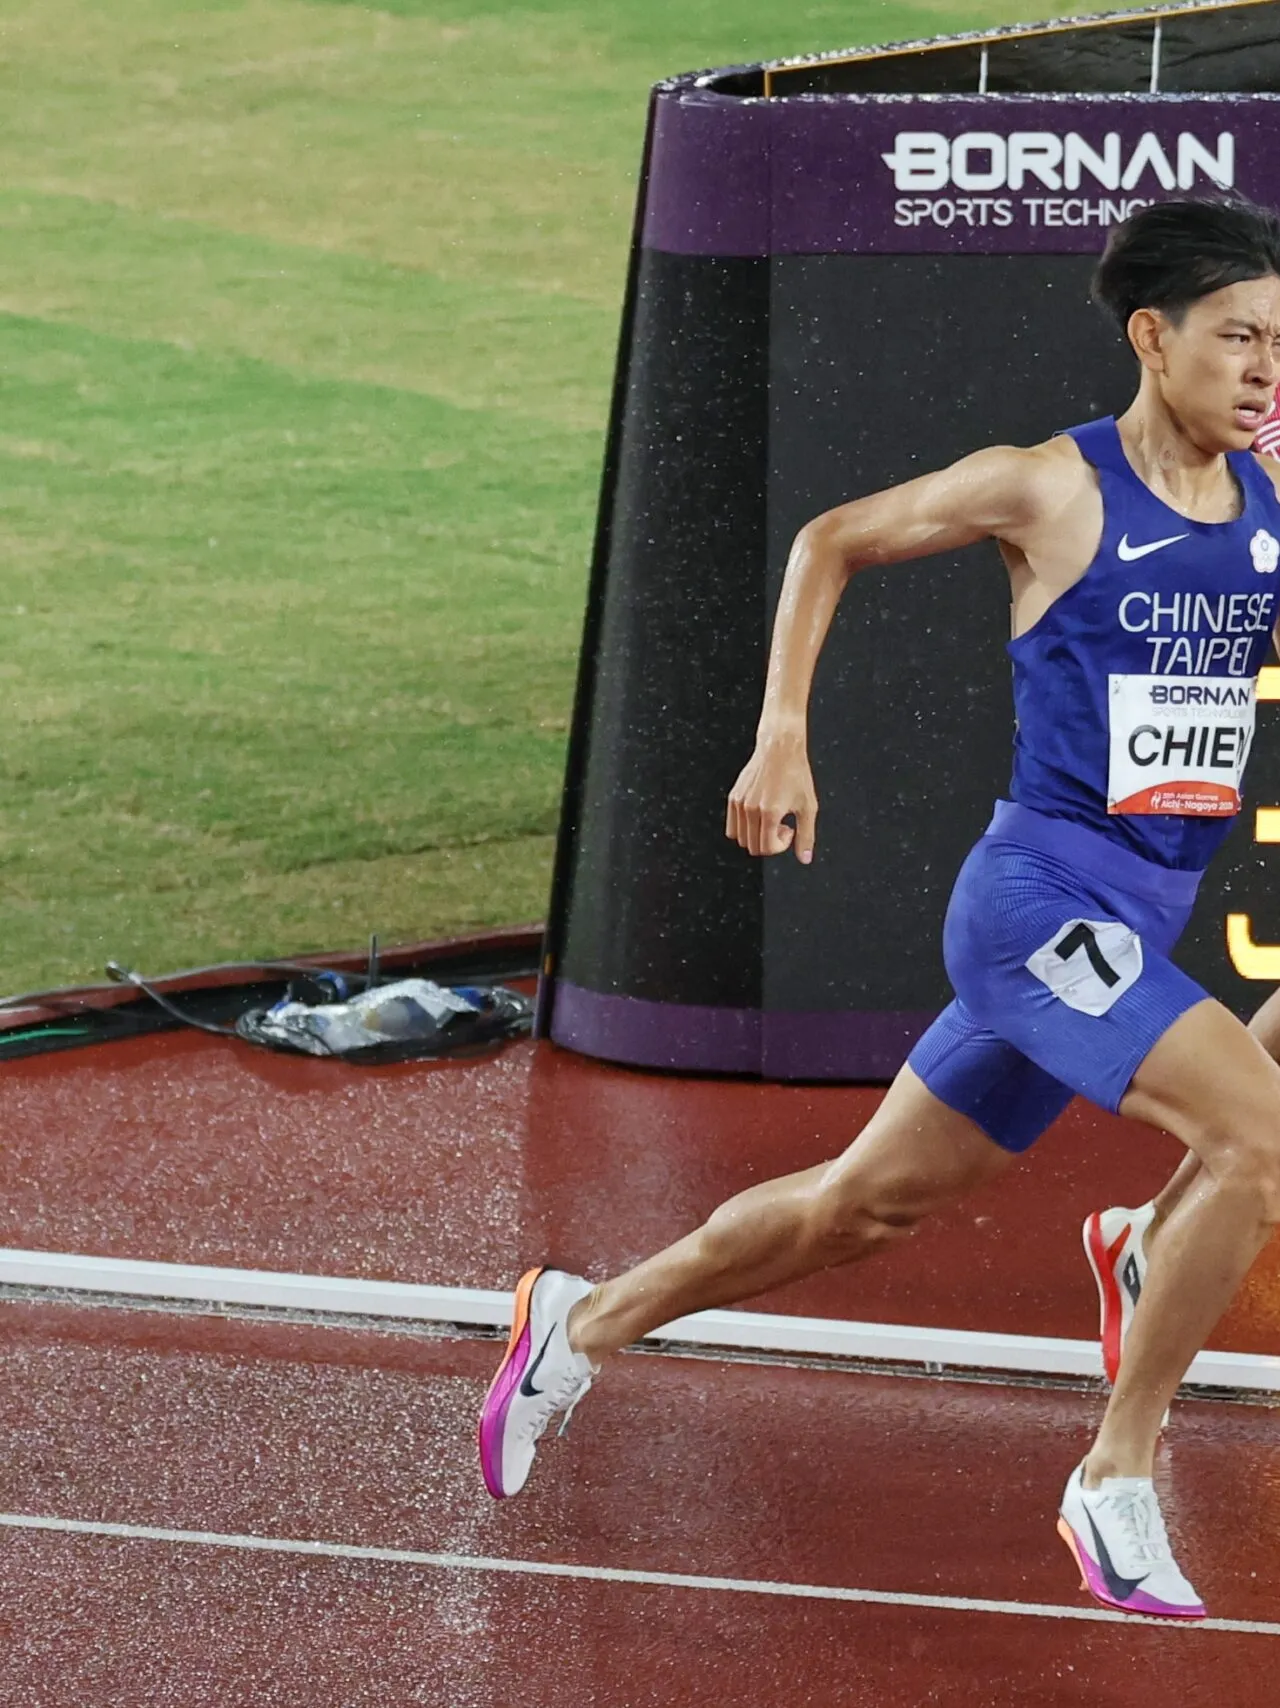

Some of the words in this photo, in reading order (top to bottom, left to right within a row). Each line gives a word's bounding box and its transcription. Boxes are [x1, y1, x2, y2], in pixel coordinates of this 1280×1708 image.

[880, 132, 1235, 191] BORNAN
[894, 199, 1013, 226] SPORTS
[1022, 199, 1155, 226] TECHNO
[1118, 591, 1273, 633] CHINESE
[1146, 637, 1253, 676] TAIPEI
[1148, 685, 1250, 706] BORNAN
[1054, 922, 1121, 989] 7
